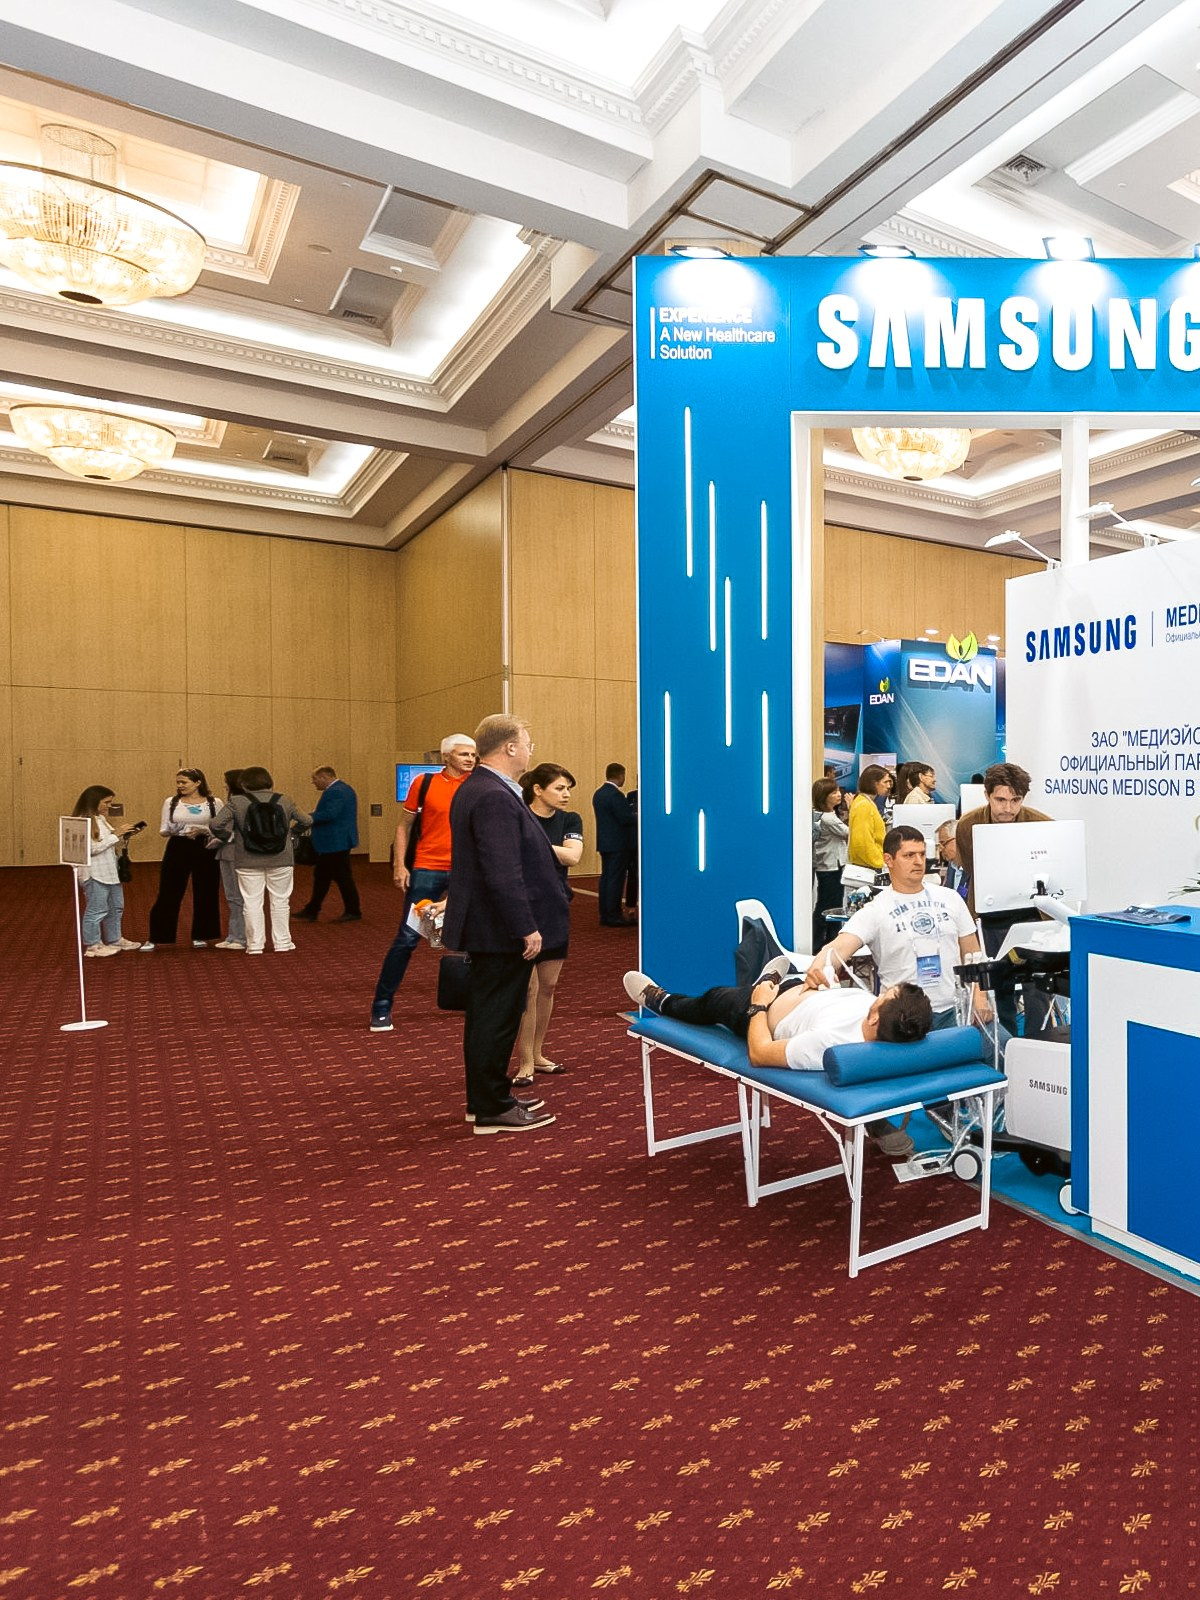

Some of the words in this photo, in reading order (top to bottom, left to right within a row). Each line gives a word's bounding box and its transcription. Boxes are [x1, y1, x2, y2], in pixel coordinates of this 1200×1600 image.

[659, 307, 752, 324] EXPERIENCE
[660, 326, 671, 342] A
[673, 327, 703, 342] New
[705, 327, 776, 343] Healthcare
[660, 345, 712, 360] Solution
[1025, 614, 1137, 663] SAMSUNG
[909, 657, 993, 687] EDAN
[869, 693, 895, 705] EDAN
[1091, 730, 1119, 747] ЗАО
[1060, 749, 1170, 775] ОФИЦИАЛЬНЫЙ
[1044, 778, 1108, 795] SAMSUNG
[1112, 778, 1180, 797] MEDISON
[1029, 1079, 1068, 1096] SAMSUNG
